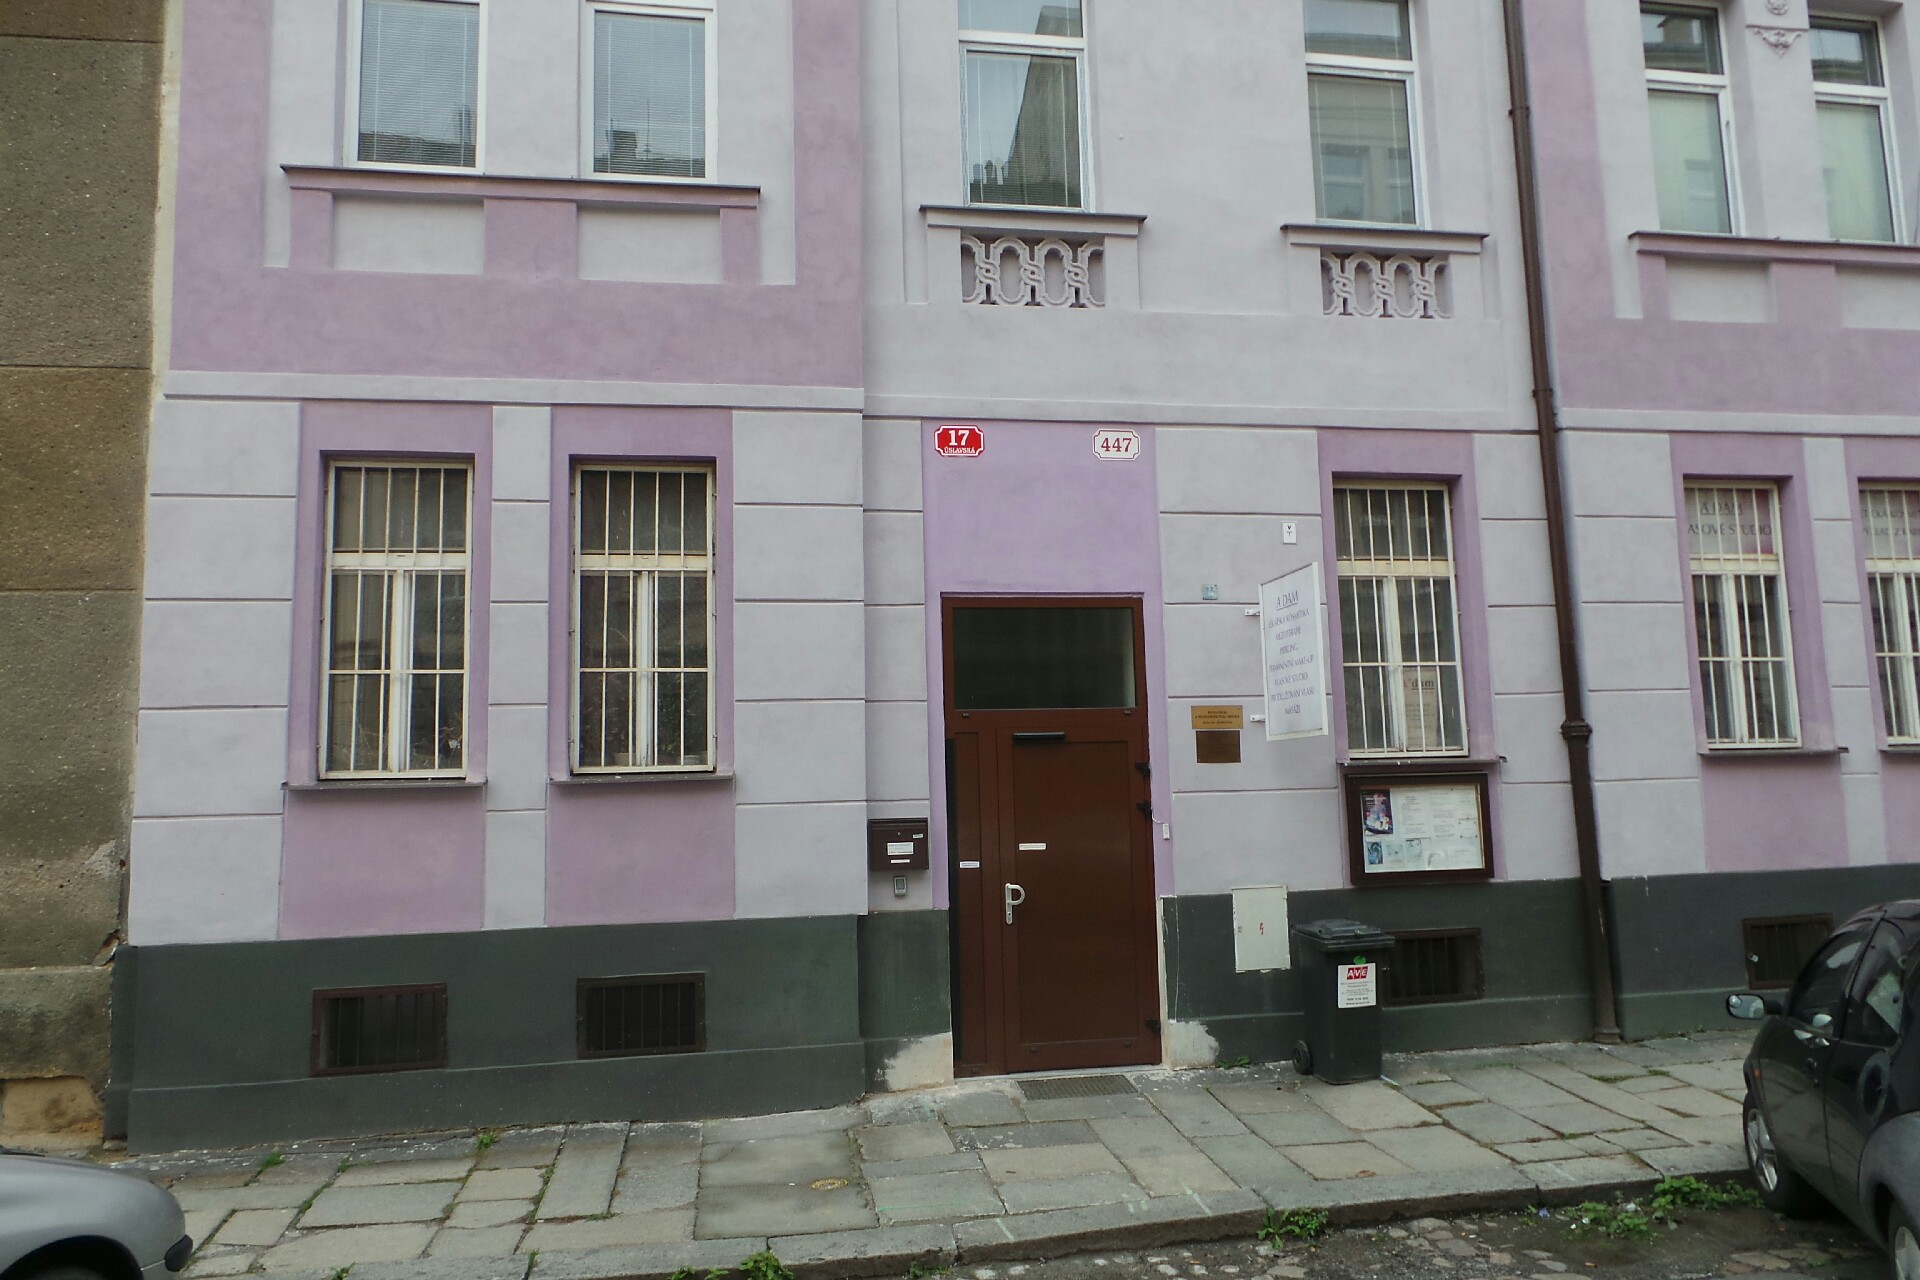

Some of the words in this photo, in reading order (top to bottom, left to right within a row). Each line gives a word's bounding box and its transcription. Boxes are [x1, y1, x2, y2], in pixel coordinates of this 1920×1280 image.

[949, 430, 970, 446] 17
[944, 446, 976, 454] ÚSLAVSKÁ
[1101, 437, 1132, 452] 447
[1348, 969, 1367, 977] AVE
